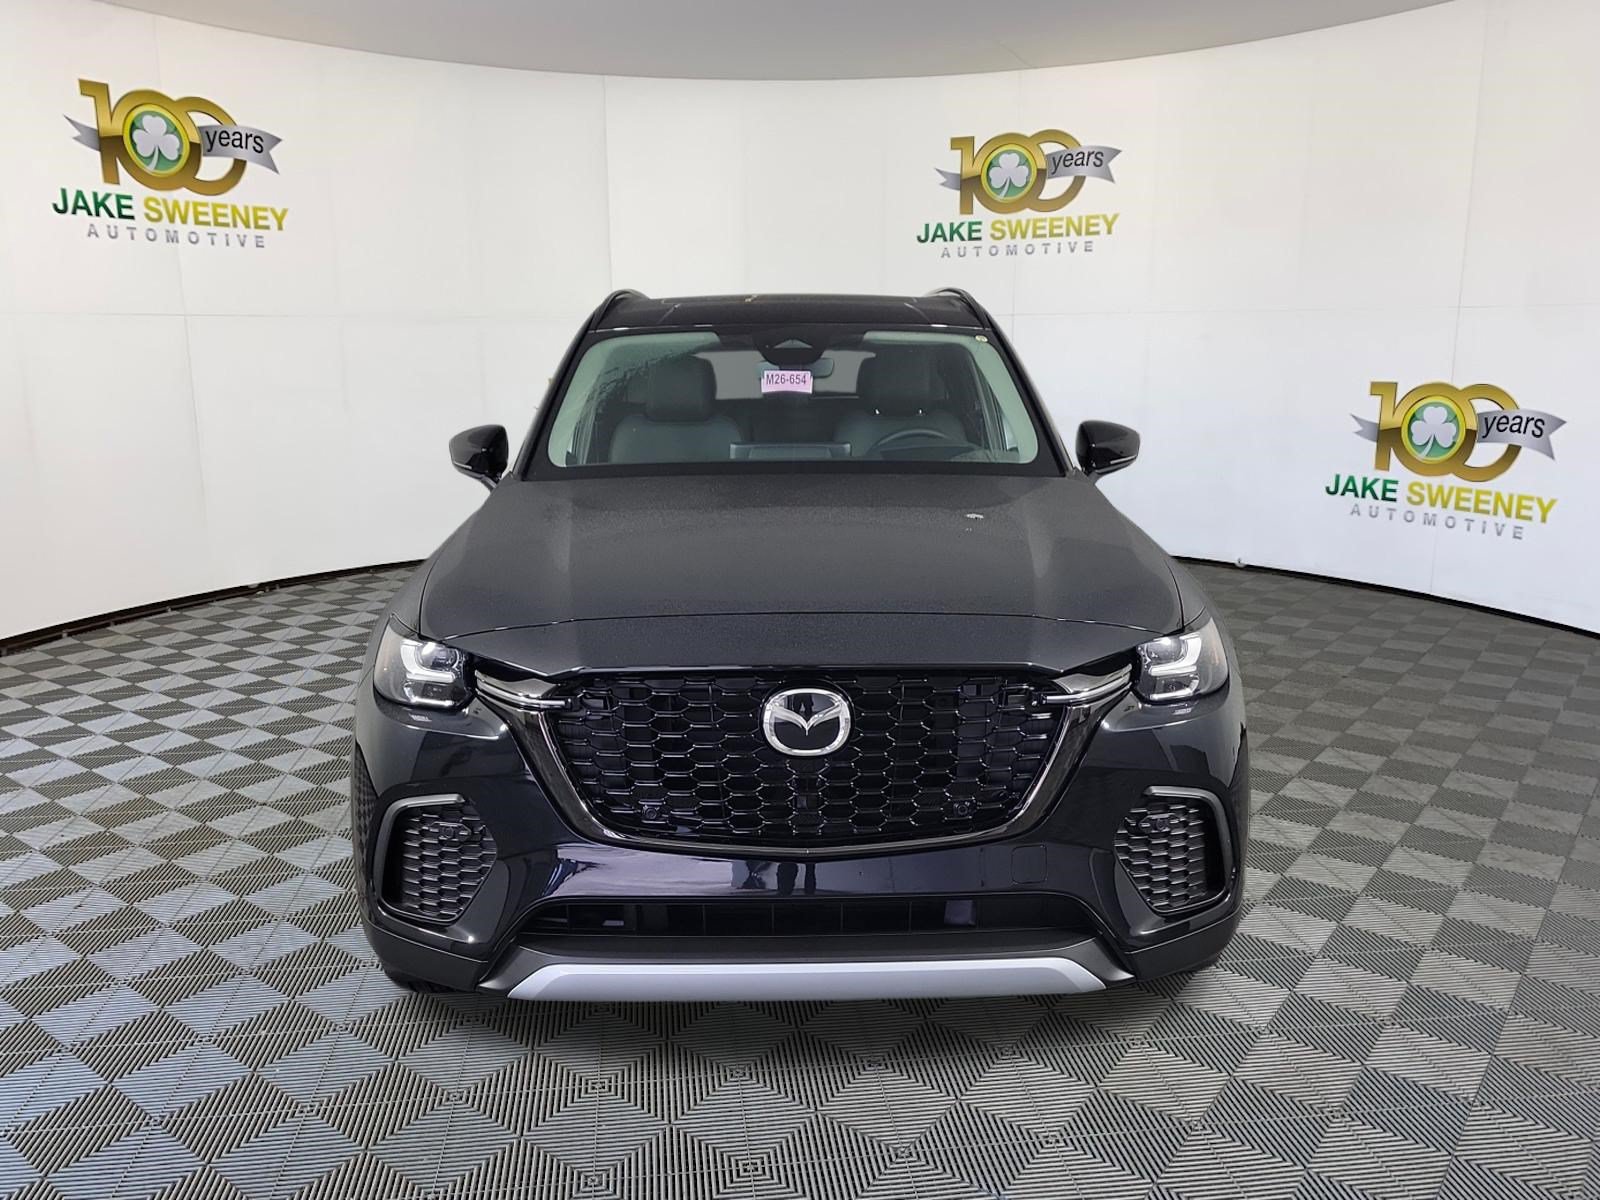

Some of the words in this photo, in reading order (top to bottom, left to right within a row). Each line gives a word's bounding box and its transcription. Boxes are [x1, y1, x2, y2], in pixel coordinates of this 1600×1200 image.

[78, 79, 248, 196] 100
[205, 130, 264, 154] years
[950, 128, 1087, 215] 100
[1050, 150, 1104, 175] years
[52, 187, 135, 220] JAKE
[143, 196, 288, 231] SWEENEY
[916, 220, 983, 243] JAKE
[990, 213, 1120, 241] SWEENEY
[87, 223, 265, 248] AUTOMOTIVE
[941, 240, 1094, 259] AUTOMOTIVE
[766, 374, 807, 385] M26-654
[1370, 381, 1523, 483] 100
[1481, 414, 1546, 439] years
[1325, 474, 1399, 502] JAKE
[1406, 481, 1558, 524] SWEENEY
[1350, 503, 1524, 540] AUTOMOTIVE
